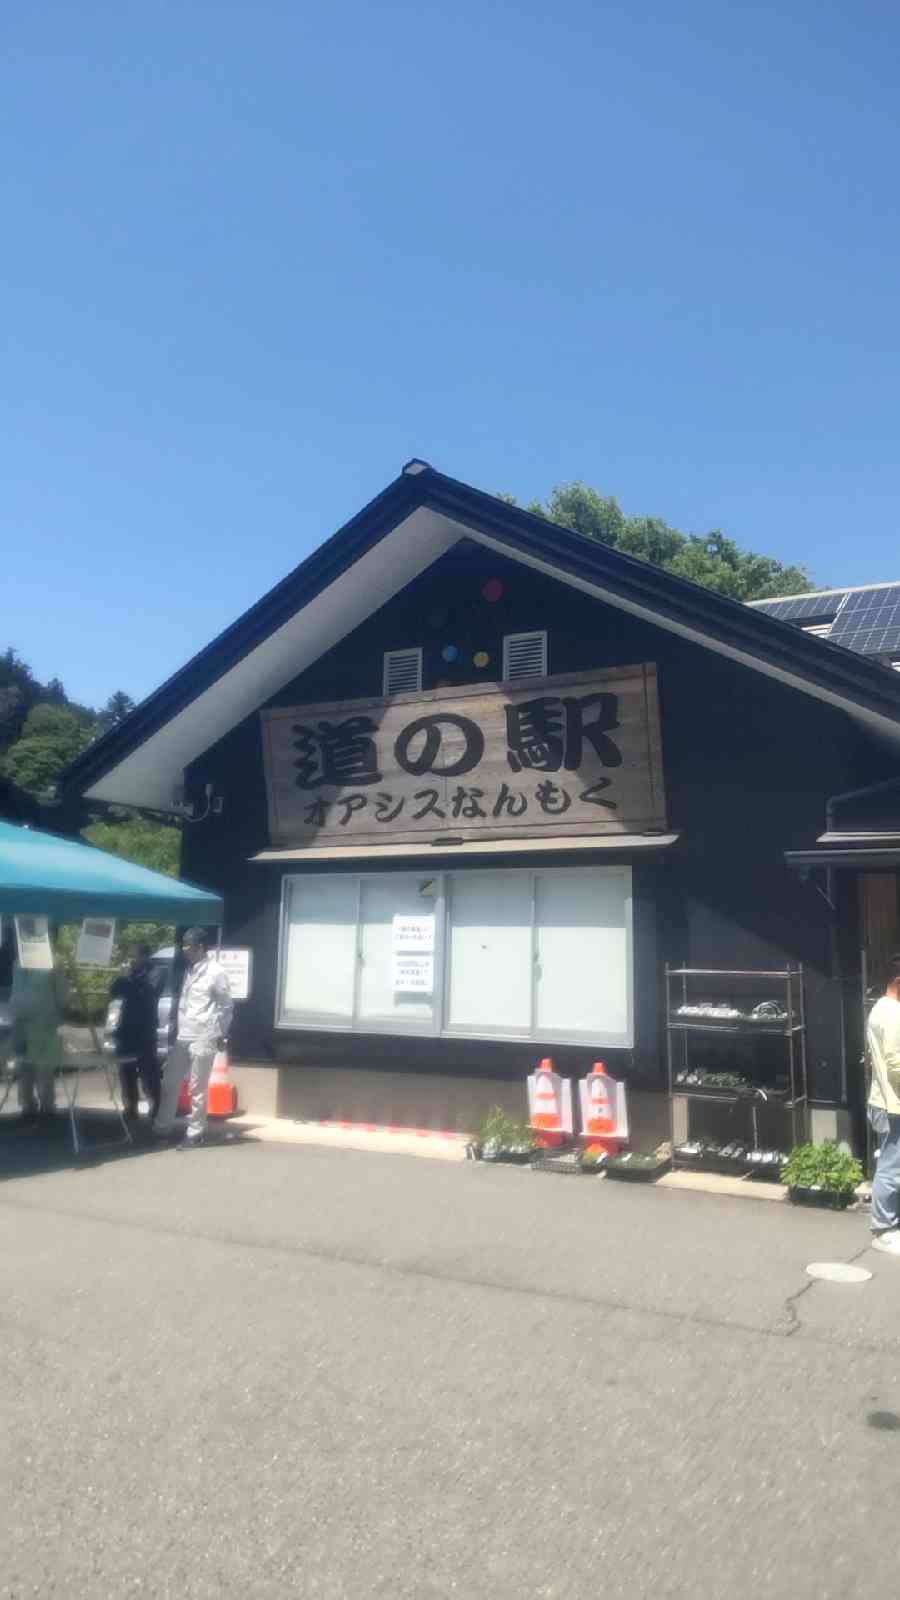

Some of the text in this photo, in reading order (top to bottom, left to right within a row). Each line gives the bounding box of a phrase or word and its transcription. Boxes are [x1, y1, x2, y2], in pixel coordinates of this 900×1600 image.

[293, 693, 623, 787] 道の駅
[305, 778, 617, 826] オアシスなんもく
